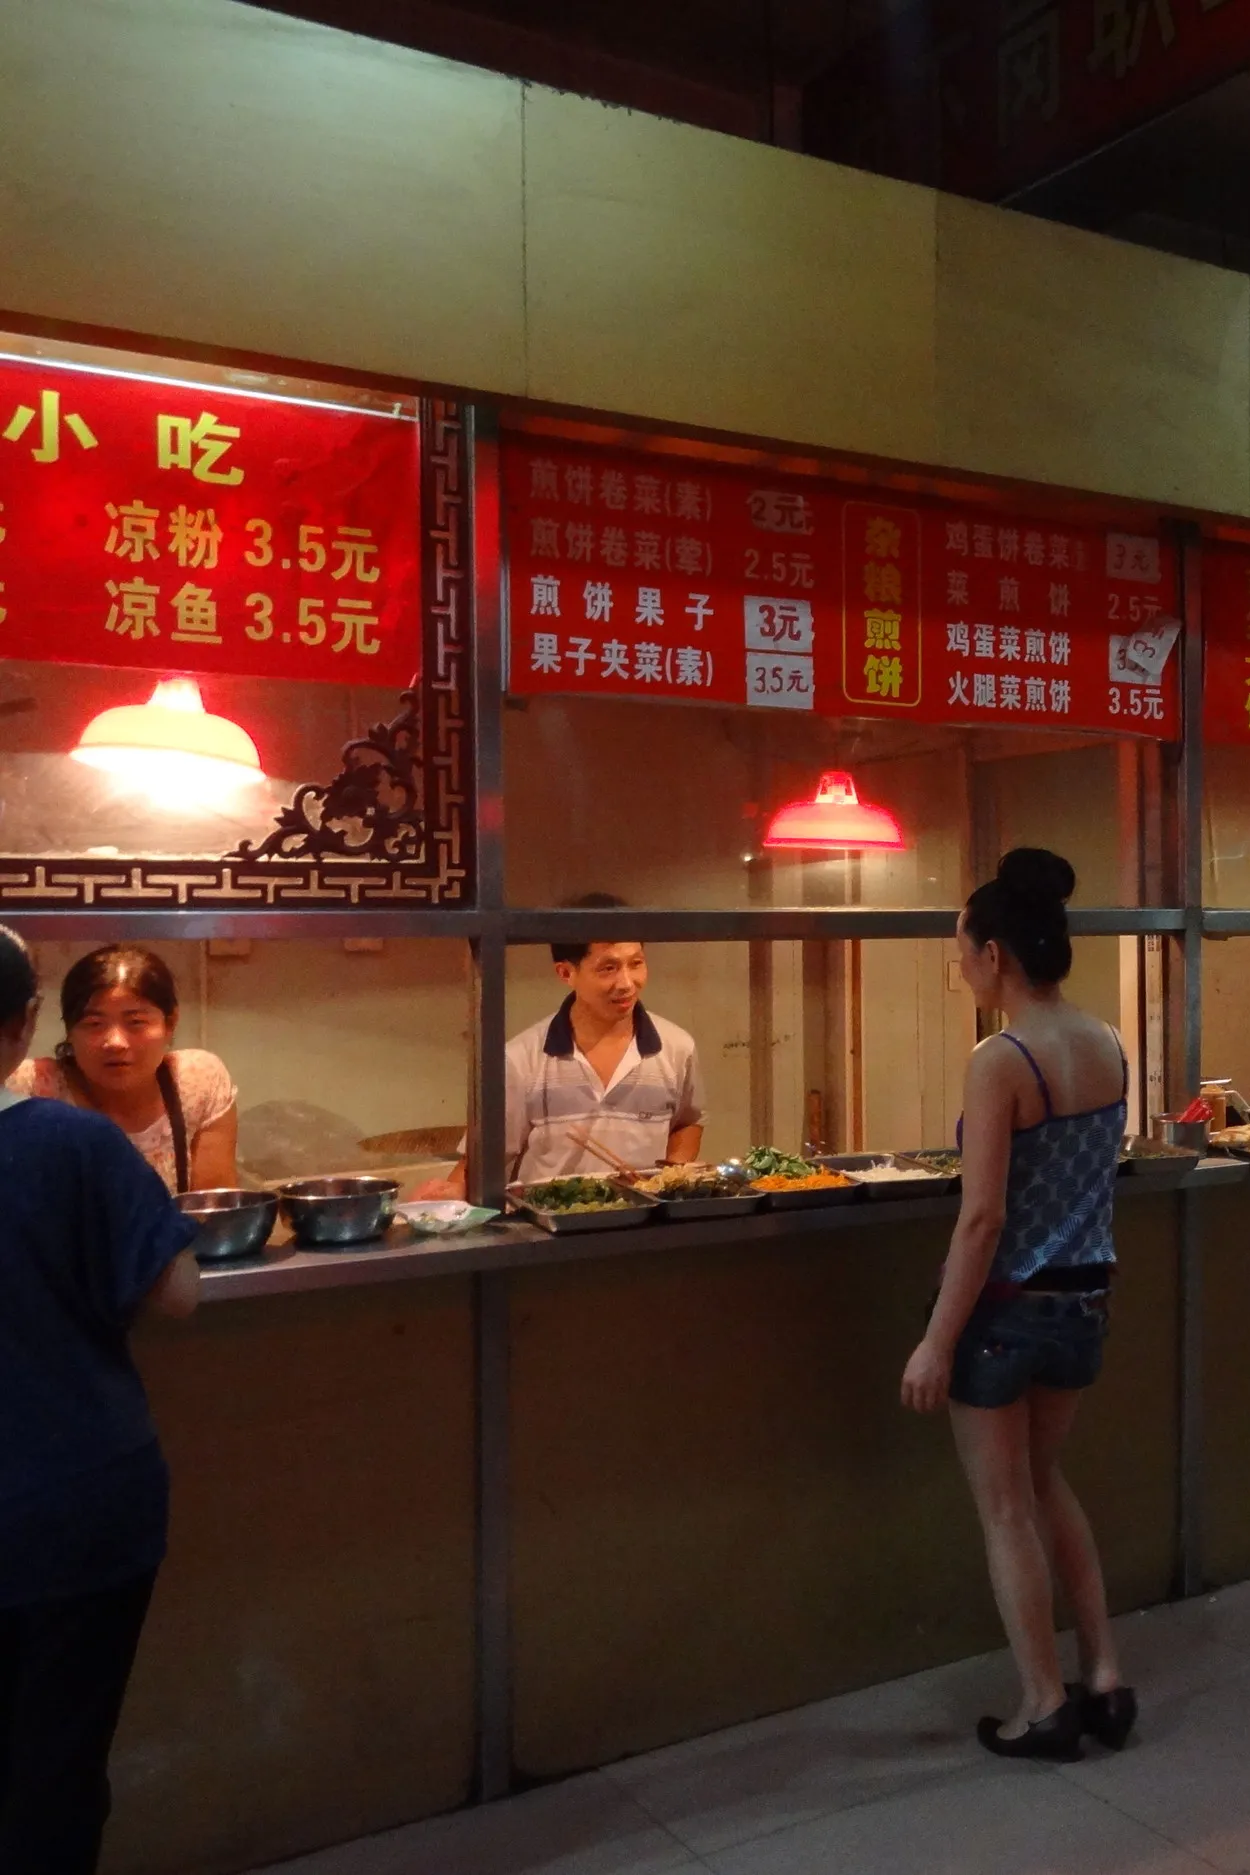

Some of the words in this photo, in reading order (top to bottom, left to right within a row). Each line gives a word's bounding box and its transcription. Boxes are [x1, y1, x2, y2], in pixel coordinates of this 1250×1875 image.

[3, 390, 245, 485] 小吃
[104, 500, 223, 569] 凉粉
[244, 519, 381, 583] 3.5元
[744, 549, 814, 588] 2.5元
[104, 577, 223, 645] 凉鱼
[244, 593, 381, 654] 3.5元
[530, 574, 714, 631] 煎饼果子
[758, 604, 802, 642] 3元
[531, 632, 713, 687] 果子夹菜(素)
[946, 621, 1071, 666] 鸡蛋菜煎饼
[948, 671, 1071, 714] 火腿菜煎饼
[1108, 687, 1165, 720] 3.5元
